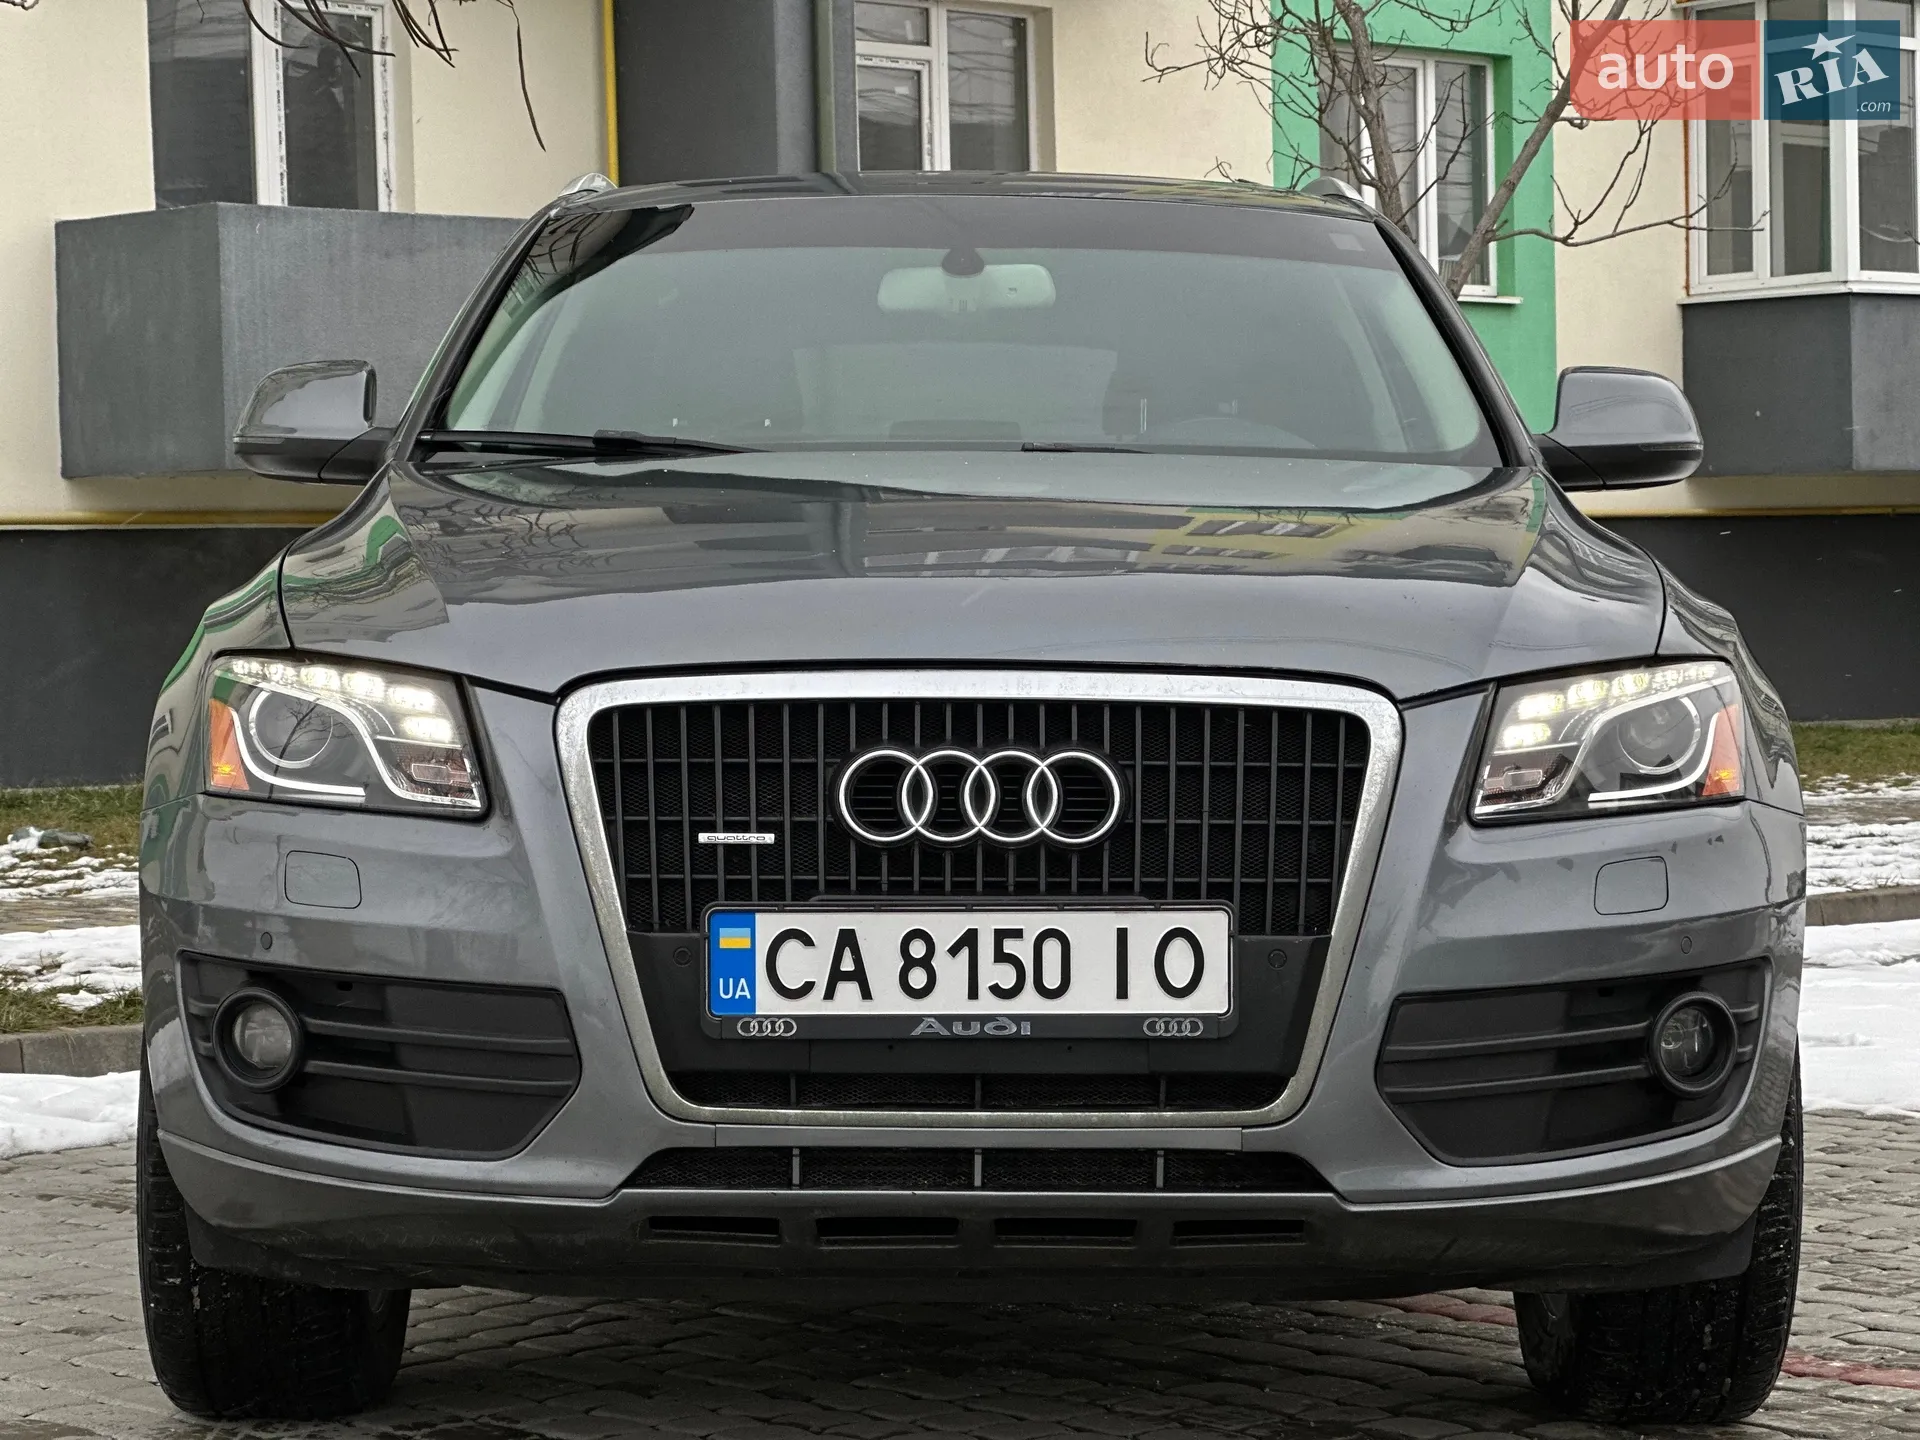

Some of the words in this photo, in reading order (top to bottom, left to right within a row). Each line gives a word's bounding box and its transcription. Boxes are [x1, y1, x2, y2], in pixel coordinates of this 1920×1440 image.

[765, 927, 874, 1001] CA
[898, 927, 1072, 1001] 8150
[719, 978, 752, 1000] UA
